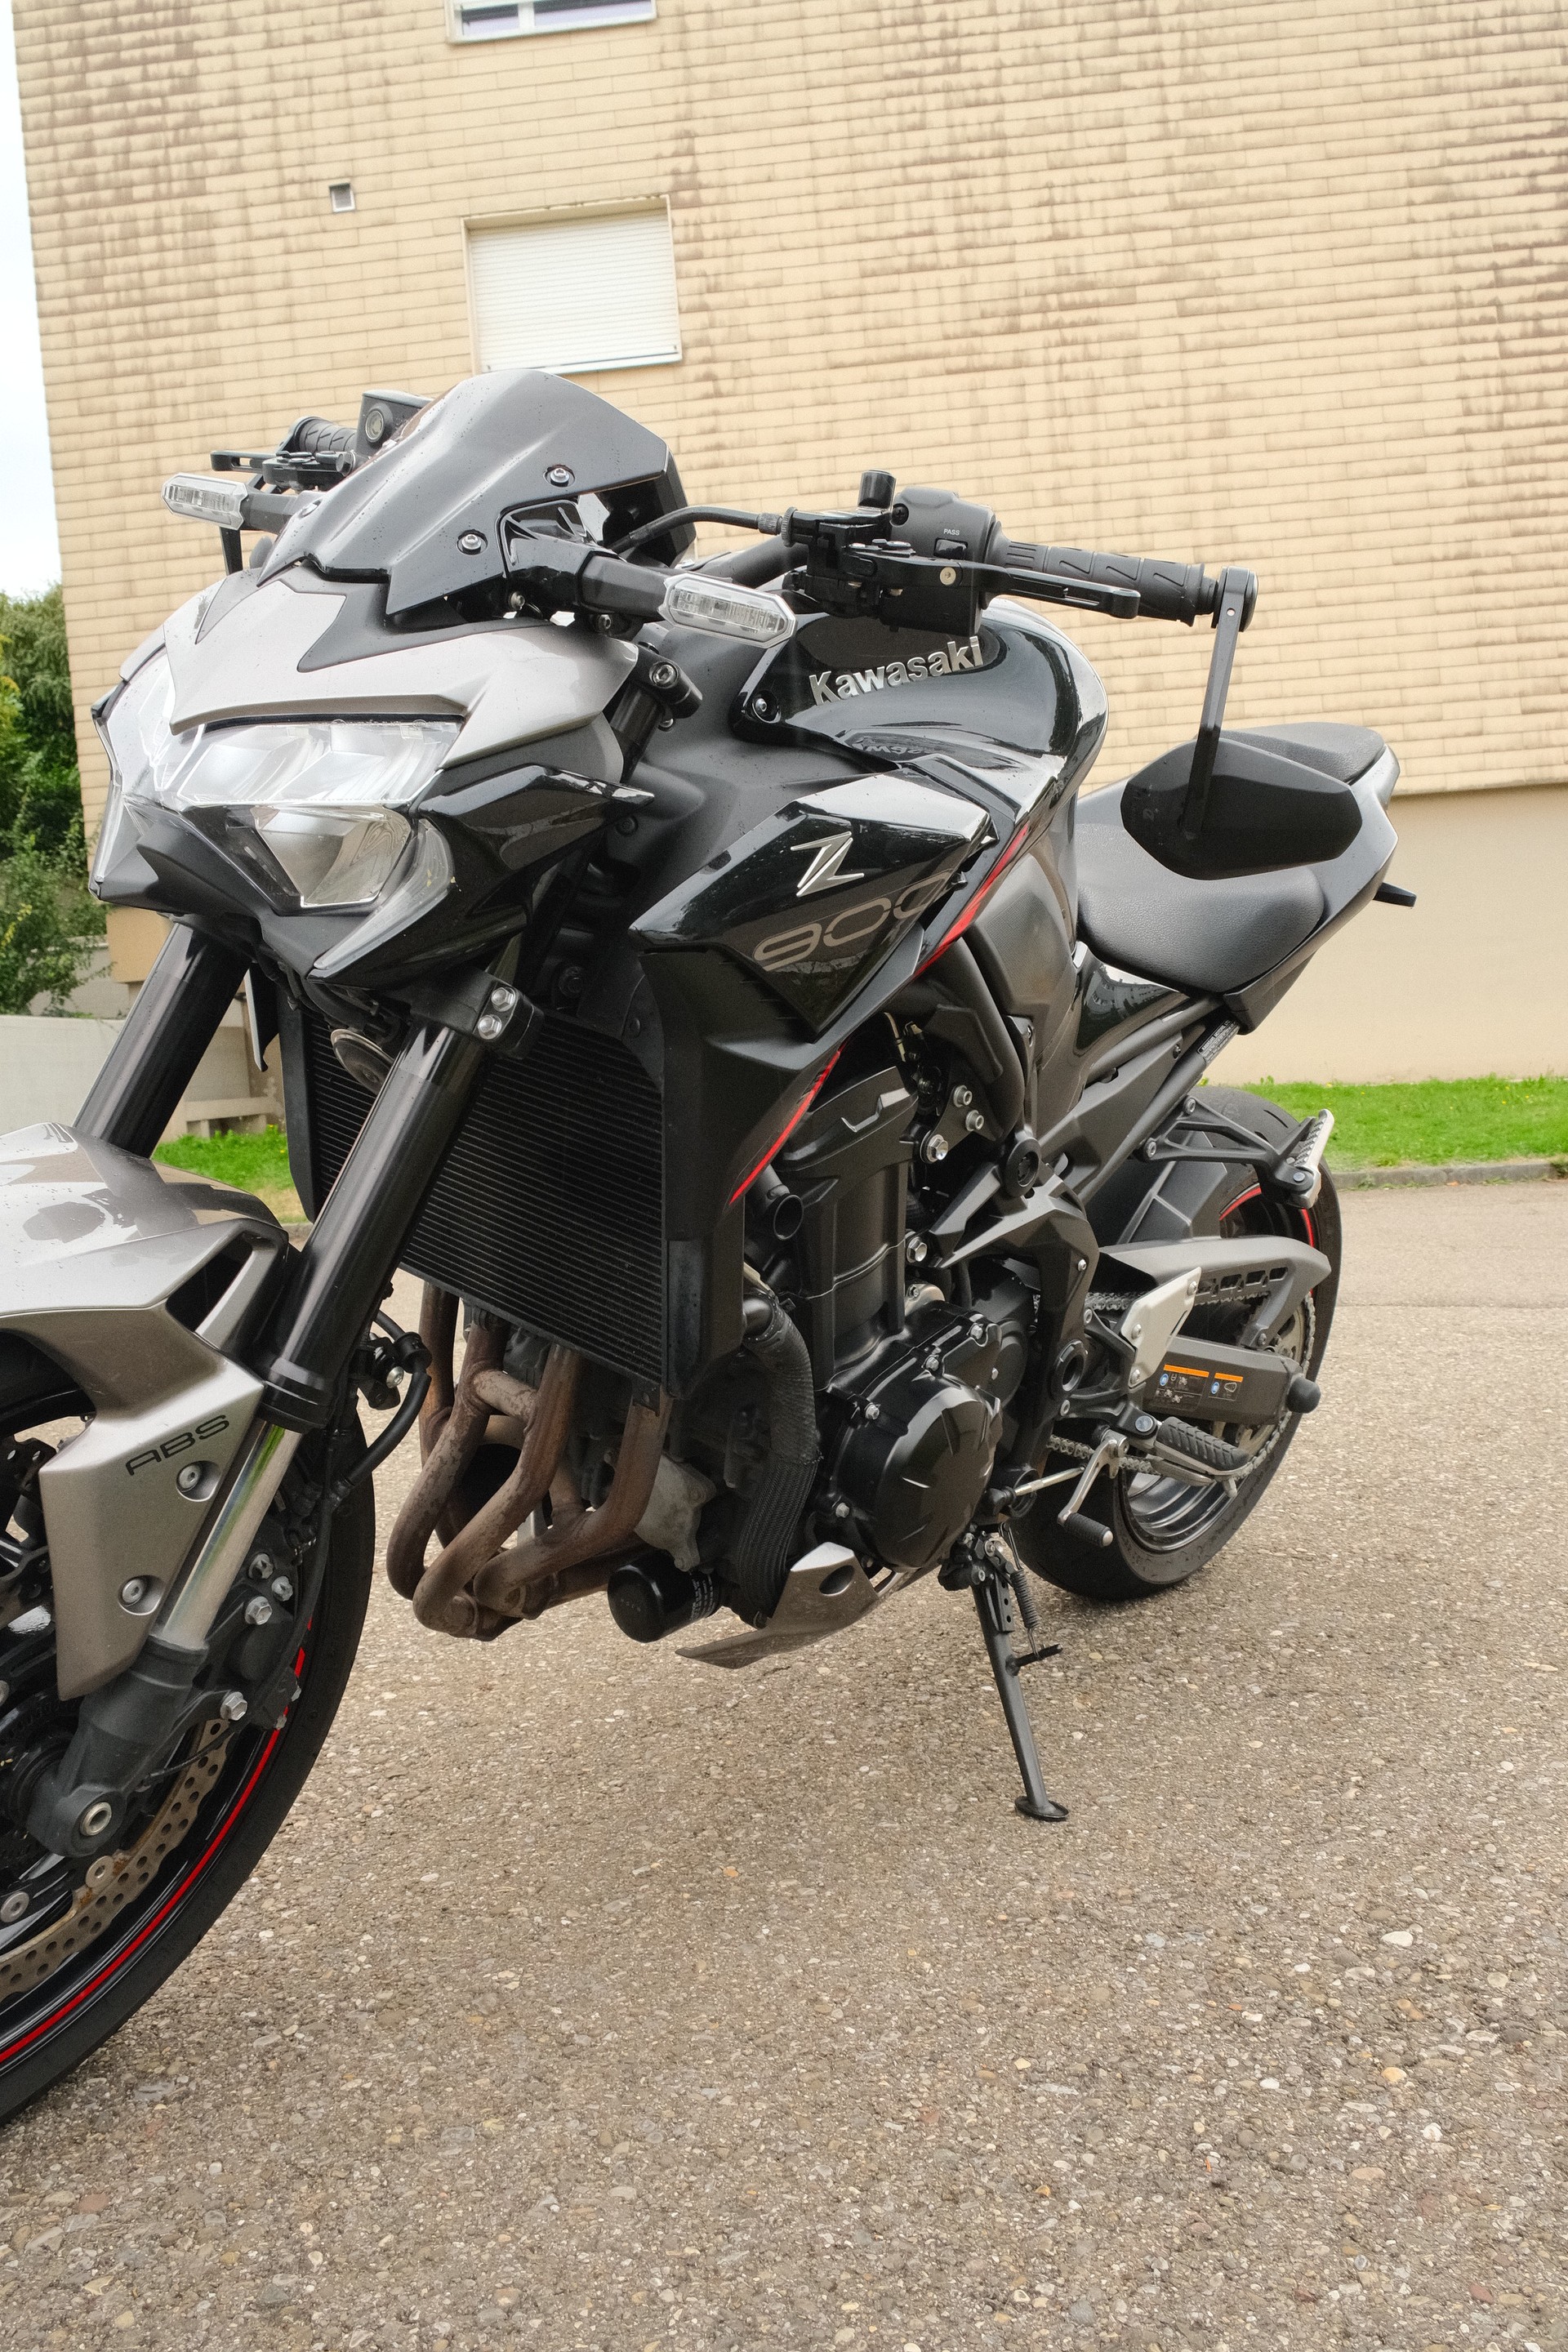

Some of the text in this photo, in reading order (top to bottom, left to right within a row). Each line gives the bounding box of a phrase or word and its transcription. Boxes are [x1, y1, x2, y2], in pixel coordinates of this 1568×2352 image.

[808, 635, 984, 706] Kawasaki
[790, 831, 865, 898] Z
[125, 1414, 230, 1477] ABS
